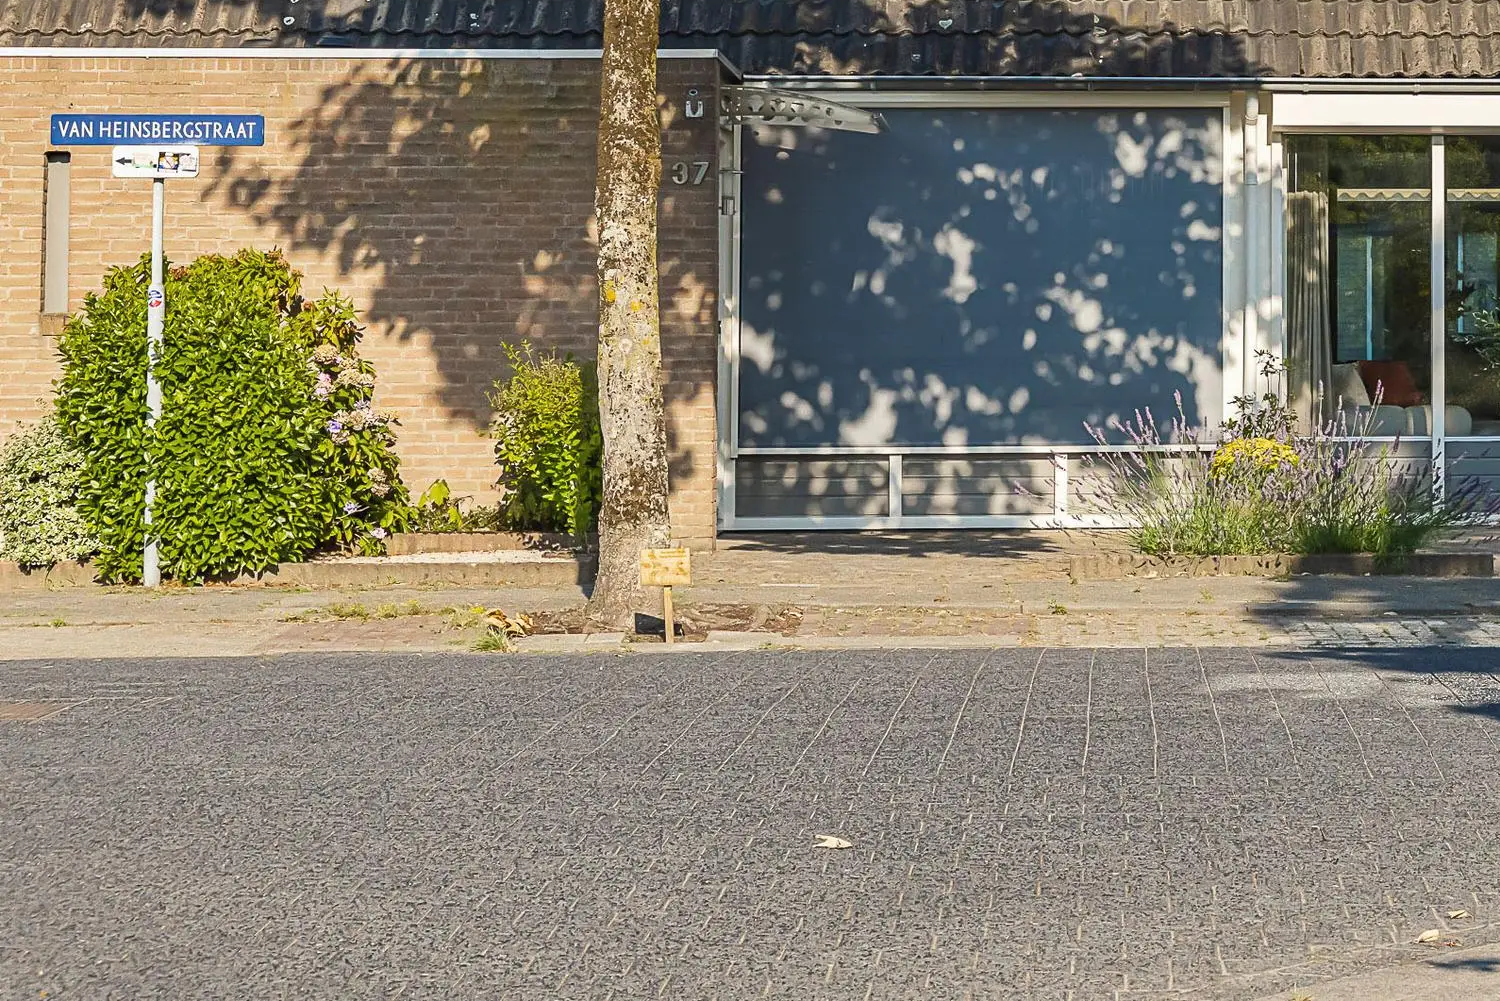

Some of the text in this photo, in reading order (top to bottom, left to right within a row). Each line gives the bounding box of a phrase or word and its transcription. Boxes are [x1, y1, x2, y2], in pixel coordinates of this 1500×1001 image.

[58, 120, 257, 139] VAN HEINSBERGSTRAAT
[671, 161, 710, 185] 37
